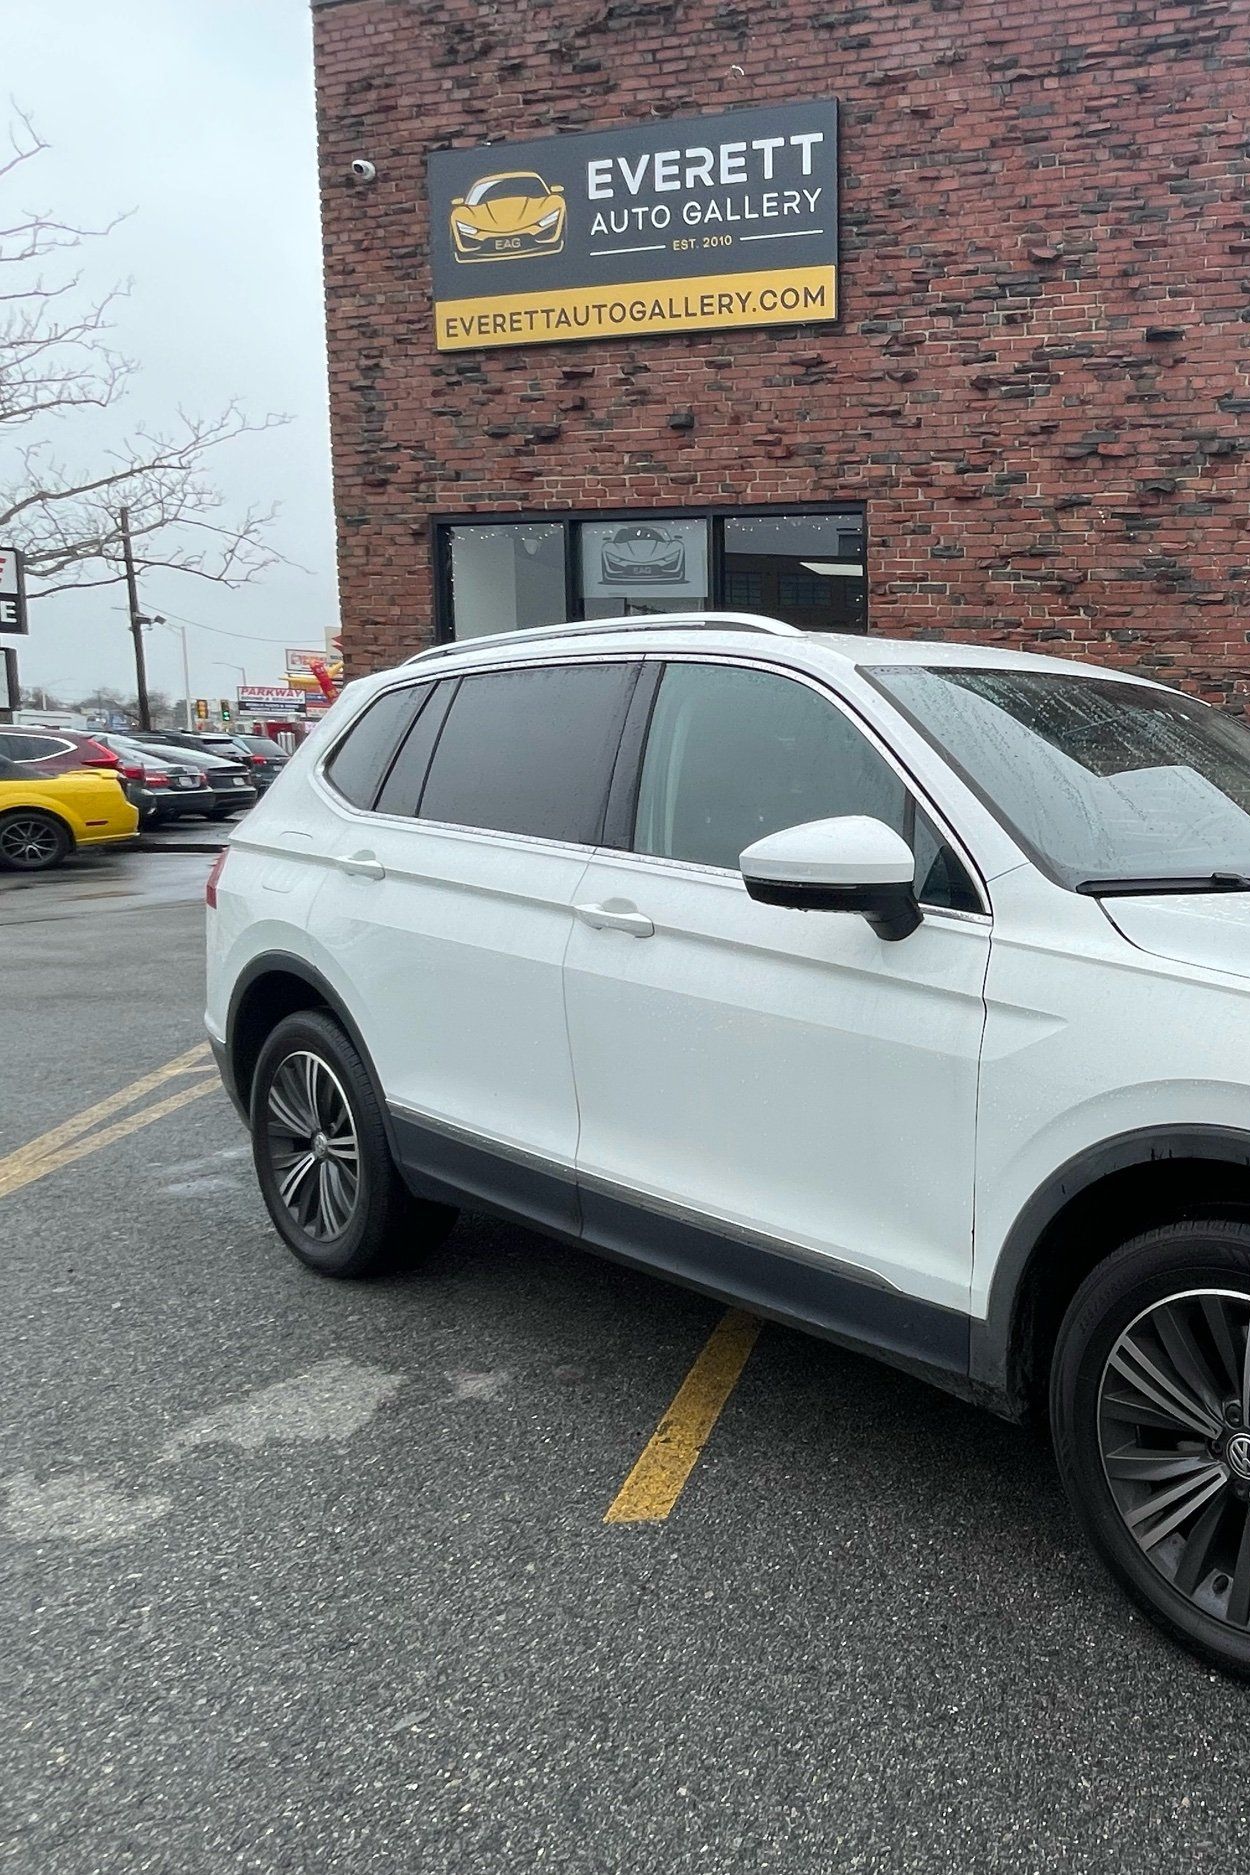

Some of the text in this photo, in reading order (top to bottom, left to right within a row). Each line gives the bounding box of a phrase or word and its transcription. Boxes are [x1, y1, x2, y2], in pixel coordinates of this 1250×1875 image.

[587, 132, 825, 200] EVERETT
[590, 187, 823, 236] AUTO GALLERY
[495, 238, 521, 250] EAG
[672, 235, 733, 251] EST. 2010
[445, 285, 826, 338] EVERETTAUTOGALLERY.COM
[240, 687, 303, 697] PARKWAY
